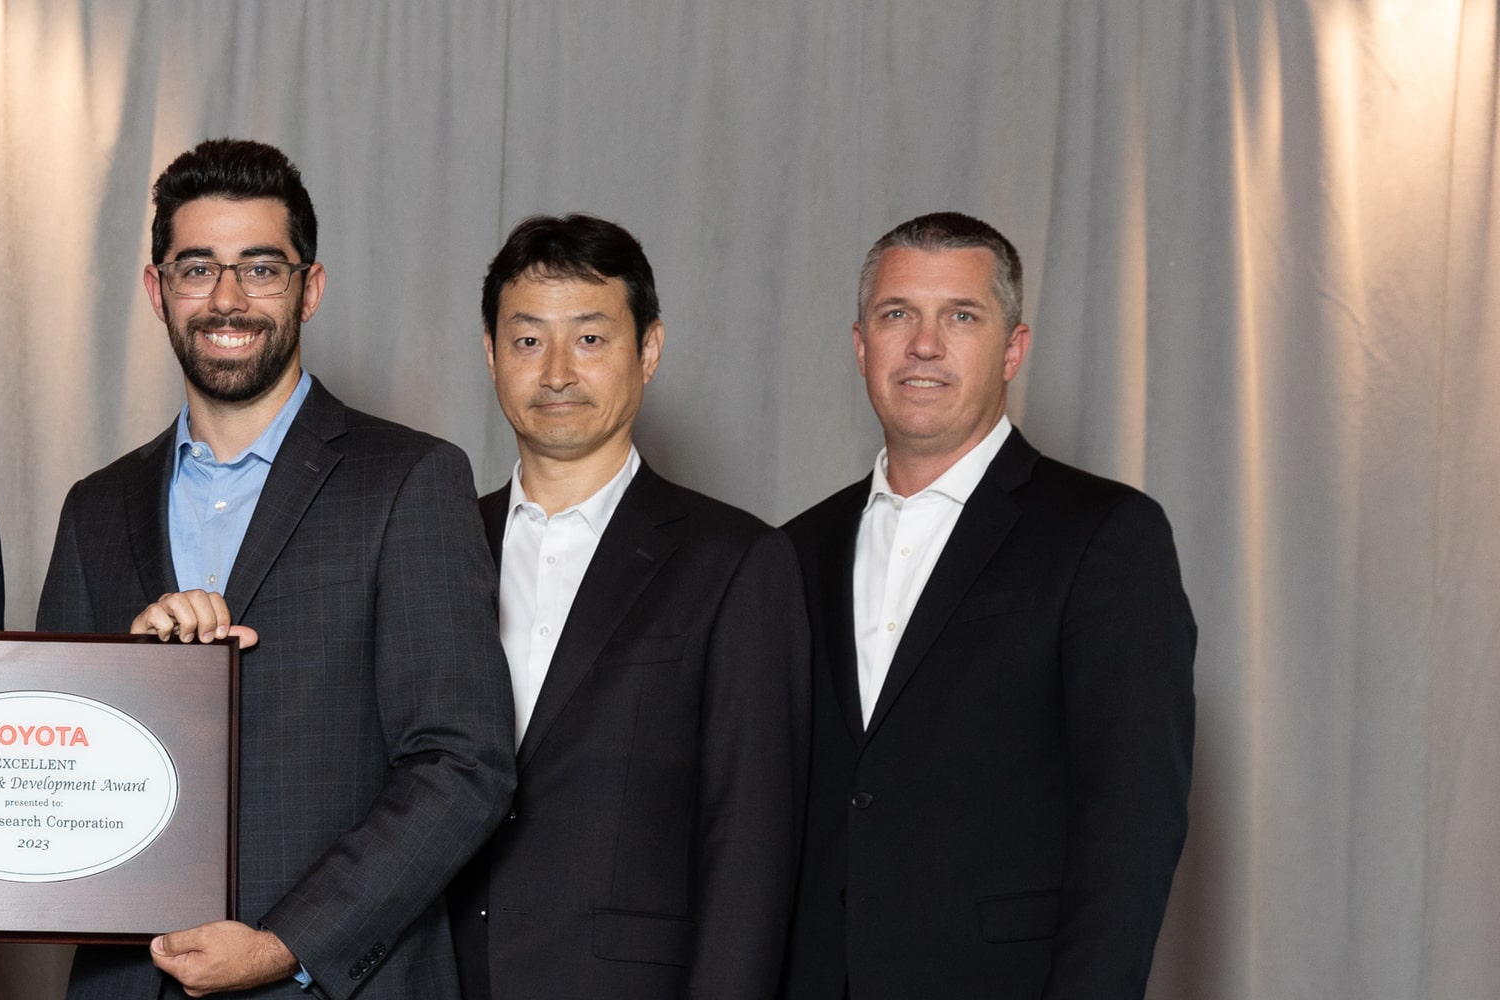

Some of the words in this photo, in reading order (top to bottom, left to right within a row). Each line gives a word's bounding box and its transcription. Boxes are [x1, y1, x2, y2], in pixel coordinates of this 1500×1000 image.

[11, 776, 97, 795] Development
[100, 778, 149, 792] Award
[4, 799, 49, 808] presented
[52, 800, 63, 808] to:
[47, 815, 124, 831] Corporation
[17, 839, 50, 850] 2023
